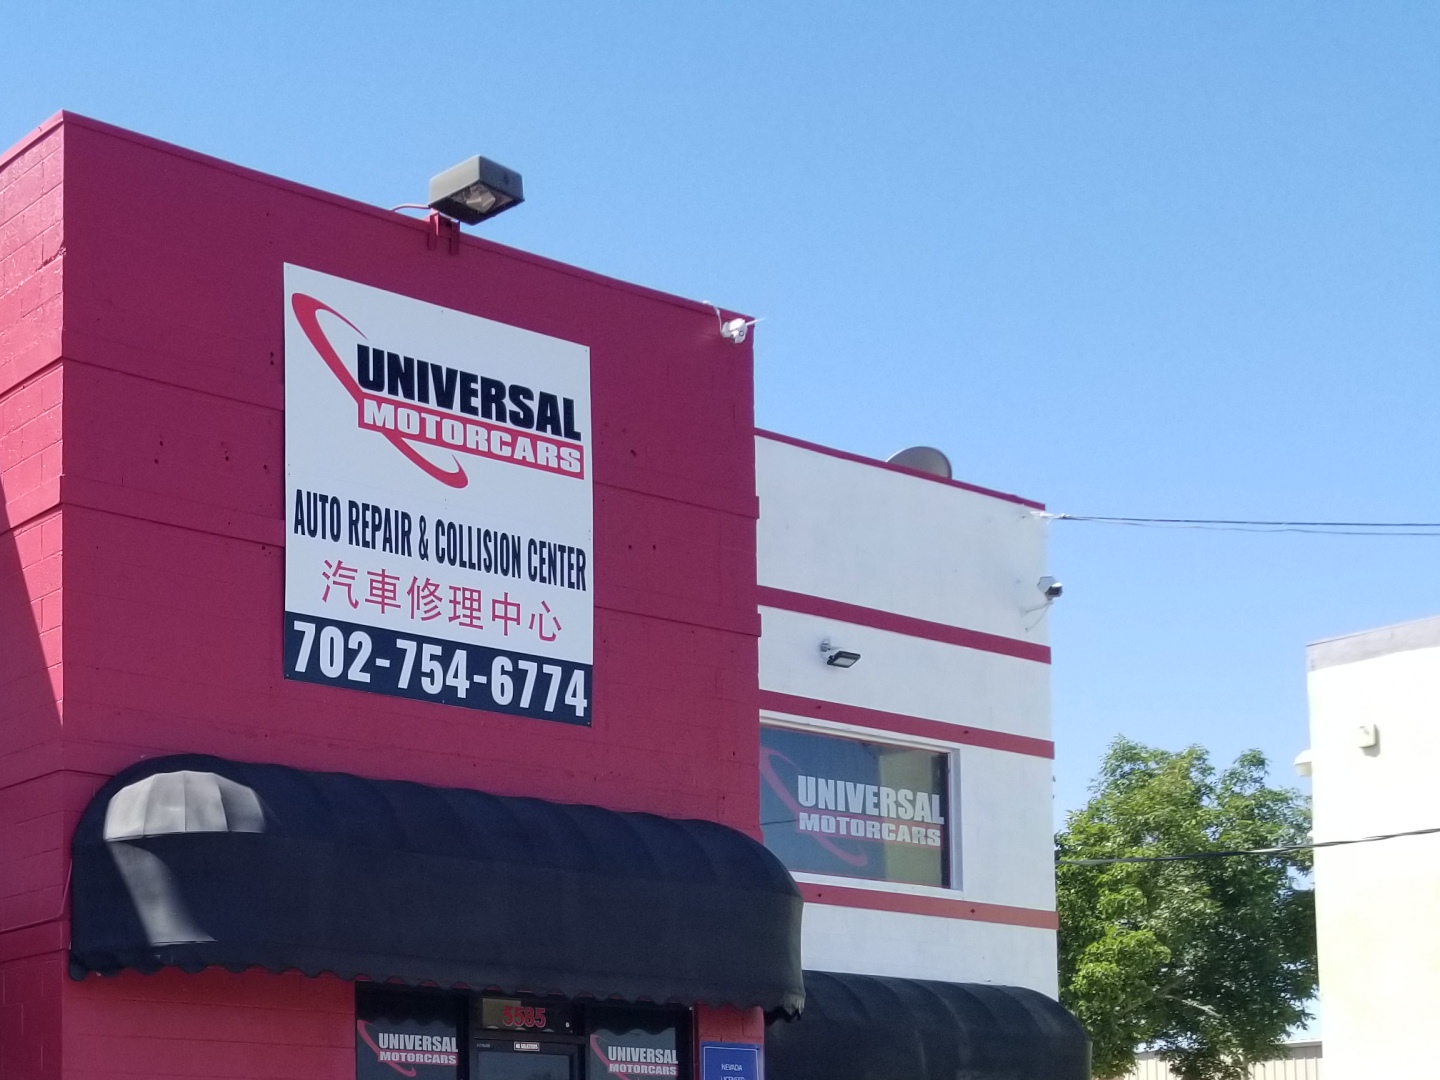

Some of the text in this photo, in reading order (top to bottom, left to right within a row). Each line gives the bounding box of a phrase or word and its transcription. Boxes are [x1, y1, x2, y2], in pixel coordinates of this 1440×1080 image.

[357, 343, 581, 441] UNIVERSAL
[363, 398, 581, 473] MOTORCARS
[293, 489, 587, 591] AUTO REPAIR & COLLISION CENTER
[321, 559, 562, 642] 汽車修理中心
[293, 620, 587, 717] 702-754-6774
[797, 774, 944, 825] UNIVERSAL
[799, 812, 941, 846] MOTORCARS
[503, 1005, 546, 1028] 5585
[378, 1032, 458, 1052] UNIVERSAL
[380, 1051, 456, 1064] MOTORCARS
[608, 1046, 678, 1064] UNIVERSAL
[609, 1064, 676, 1075] MOTORCARS
